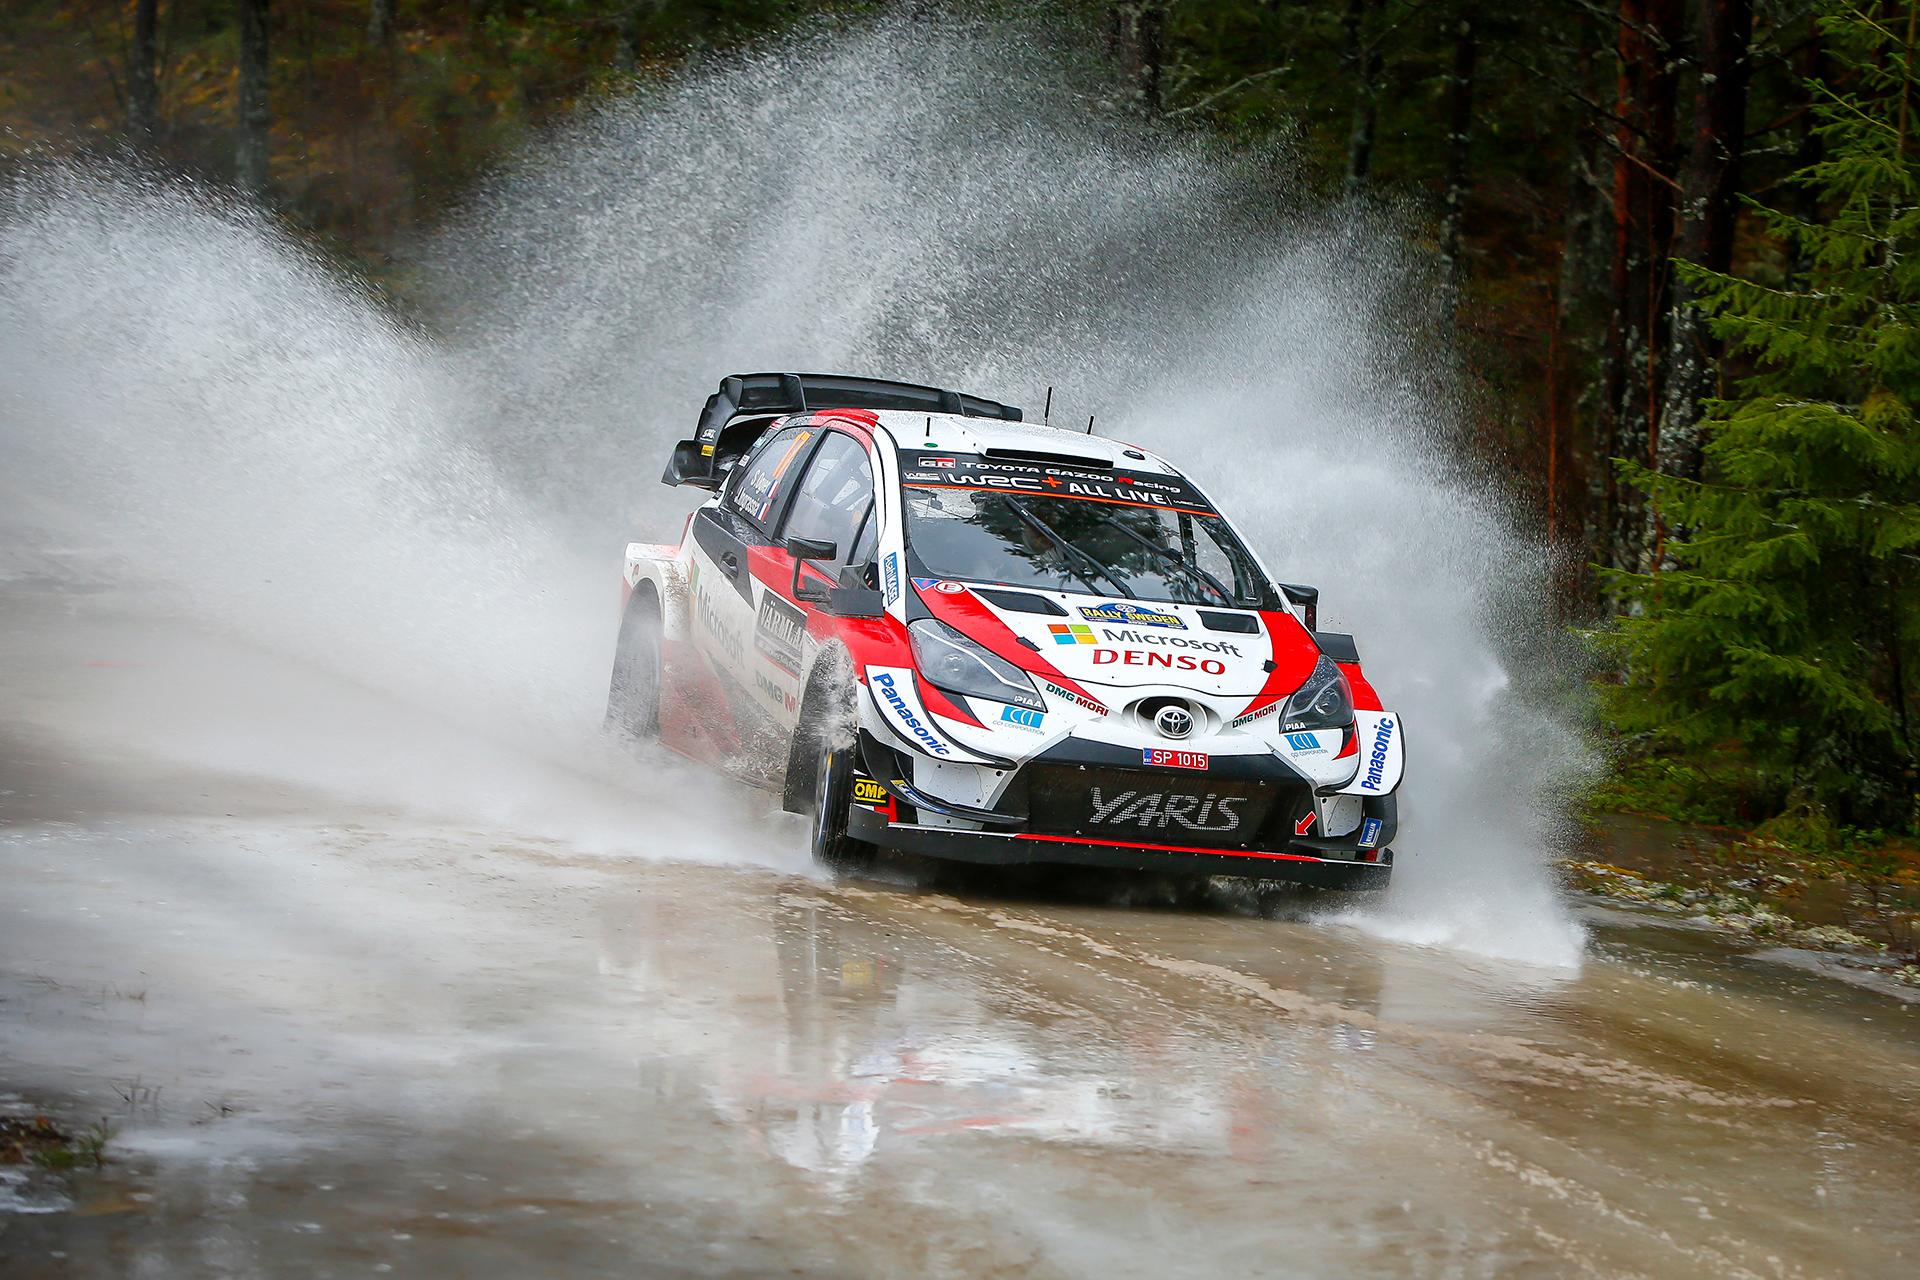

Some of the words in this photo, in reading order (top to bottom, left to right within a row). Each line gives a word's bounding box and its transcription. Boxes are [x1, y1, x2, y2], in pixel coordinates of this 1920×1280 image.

[919, 459, 954, 468] GR
[961, 462, 1040, 474] TOYOTA
[1045, 467, 1114, 482] GAZOO
[1117, 476, 1181, 494] Racing
[1069, 482, 1112, 498] ALL
[1115, 488, 1167, 505] LIVE
[1082, 608, 1122, 618] RALLY
[1126, 612, 1180, 625] SWEDEN
[1103, 628, 1243, 658] Microsoft
[1092, 649, 1226, 675] DENSO
[1014, 695, 1041, 707] PIAA
[1045, 683, 1075, 701] DMG
[1075, 697, 1109, 717] MORI
[872, 672, 950, 756] Panasonic
[1232, 714, 1253, 728] DMG
[1254, 704, 1277, 719] MORI
[1285, 722, 1306, 731] PIAA
[1153, 751, 1173, 764] SP
[1177, 753, 1206, 767] 1015
[1361, 717, 1394, 791] Panasonic
[855, 783, 887, 799] OMP
